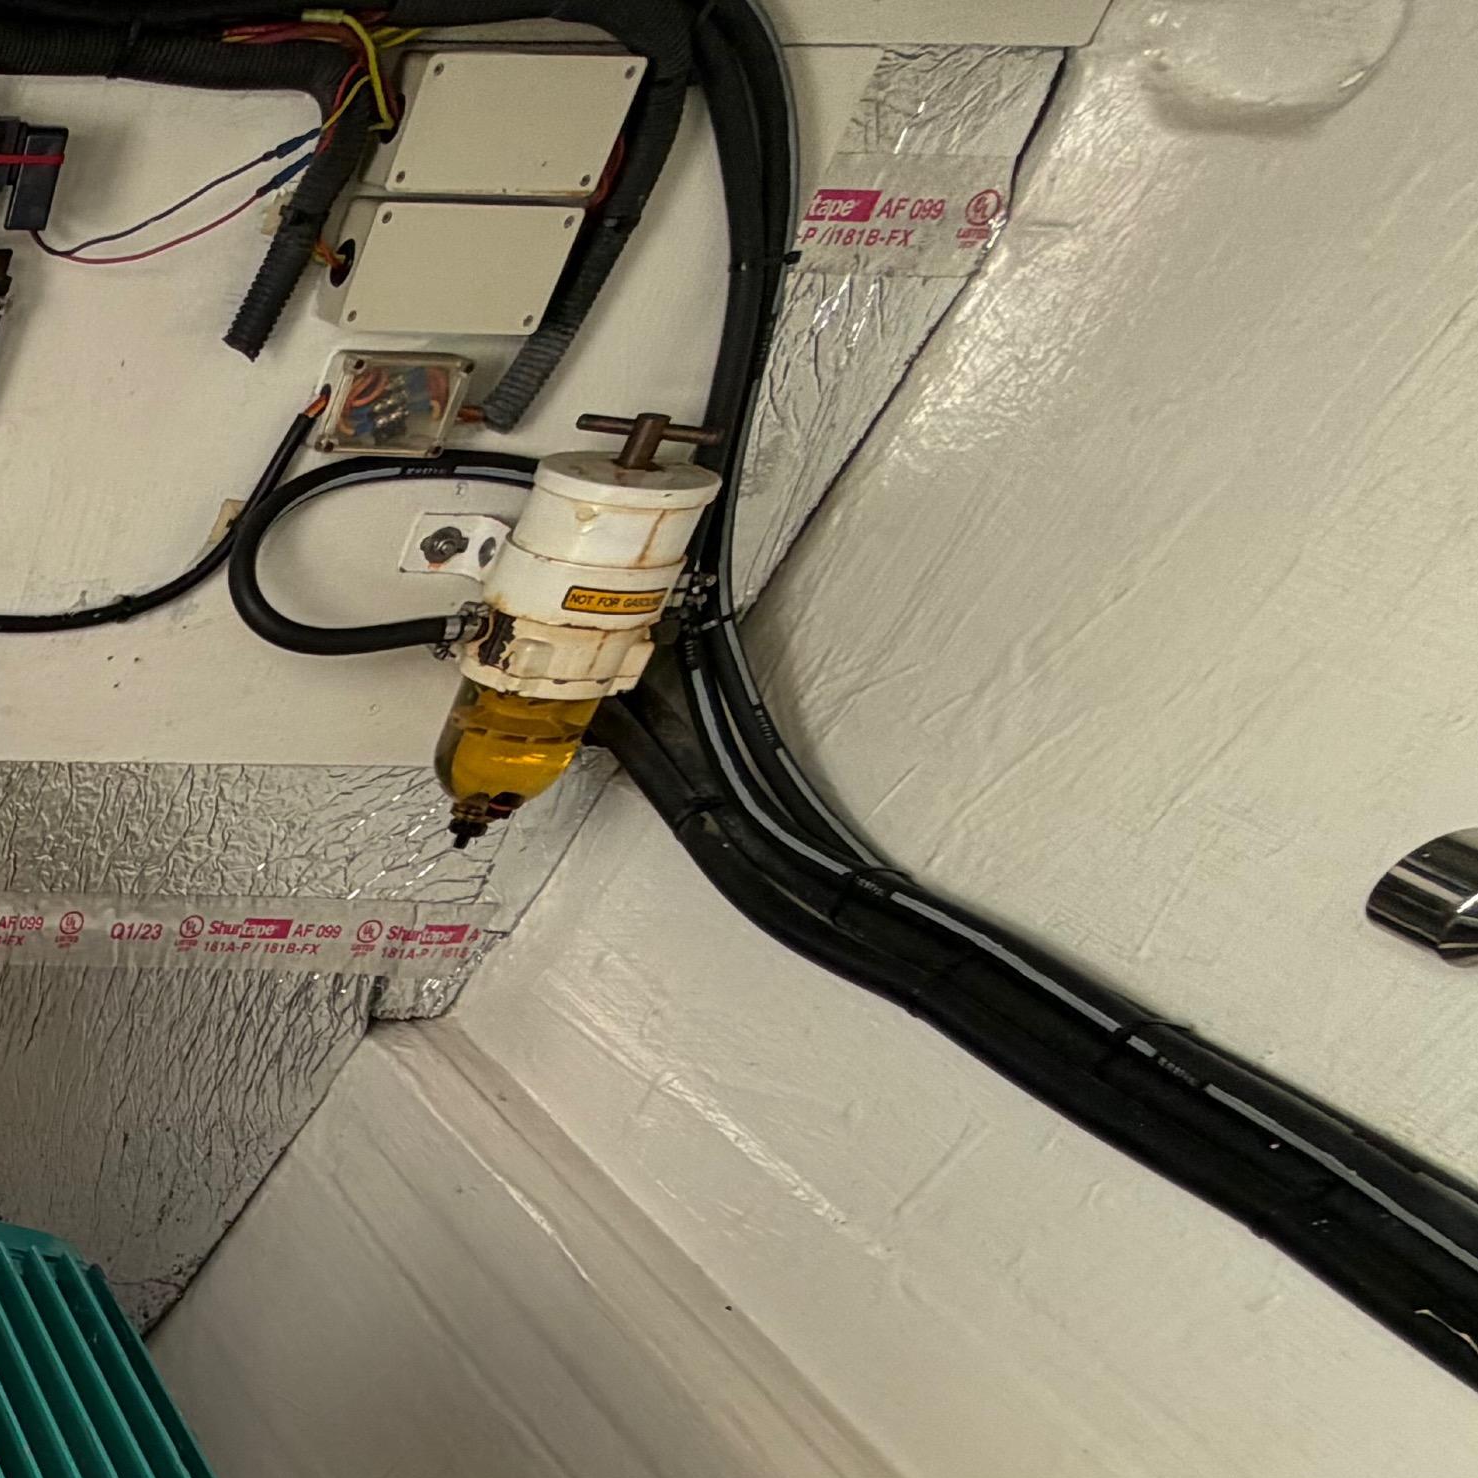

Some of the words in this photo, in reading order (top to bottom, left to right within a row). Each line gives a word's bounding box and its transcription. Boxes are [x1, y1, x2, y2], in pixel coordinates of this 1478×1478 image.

[877, 198, 910, 219] AF
[910, 198, 946, 220] 099
[570, 593, 595, 605] NOT
[597, 596, 621, 608] FOR
[110, 923, 163, 941] Q1/23
[208, 919, 275, 939] Shurtape
[293, 924, 314, 938] AF
[316, 924, 342, 939] 099
[203, 942, 251, 954] 181A-P
[264, 942, 321, 955] 181B-FX
